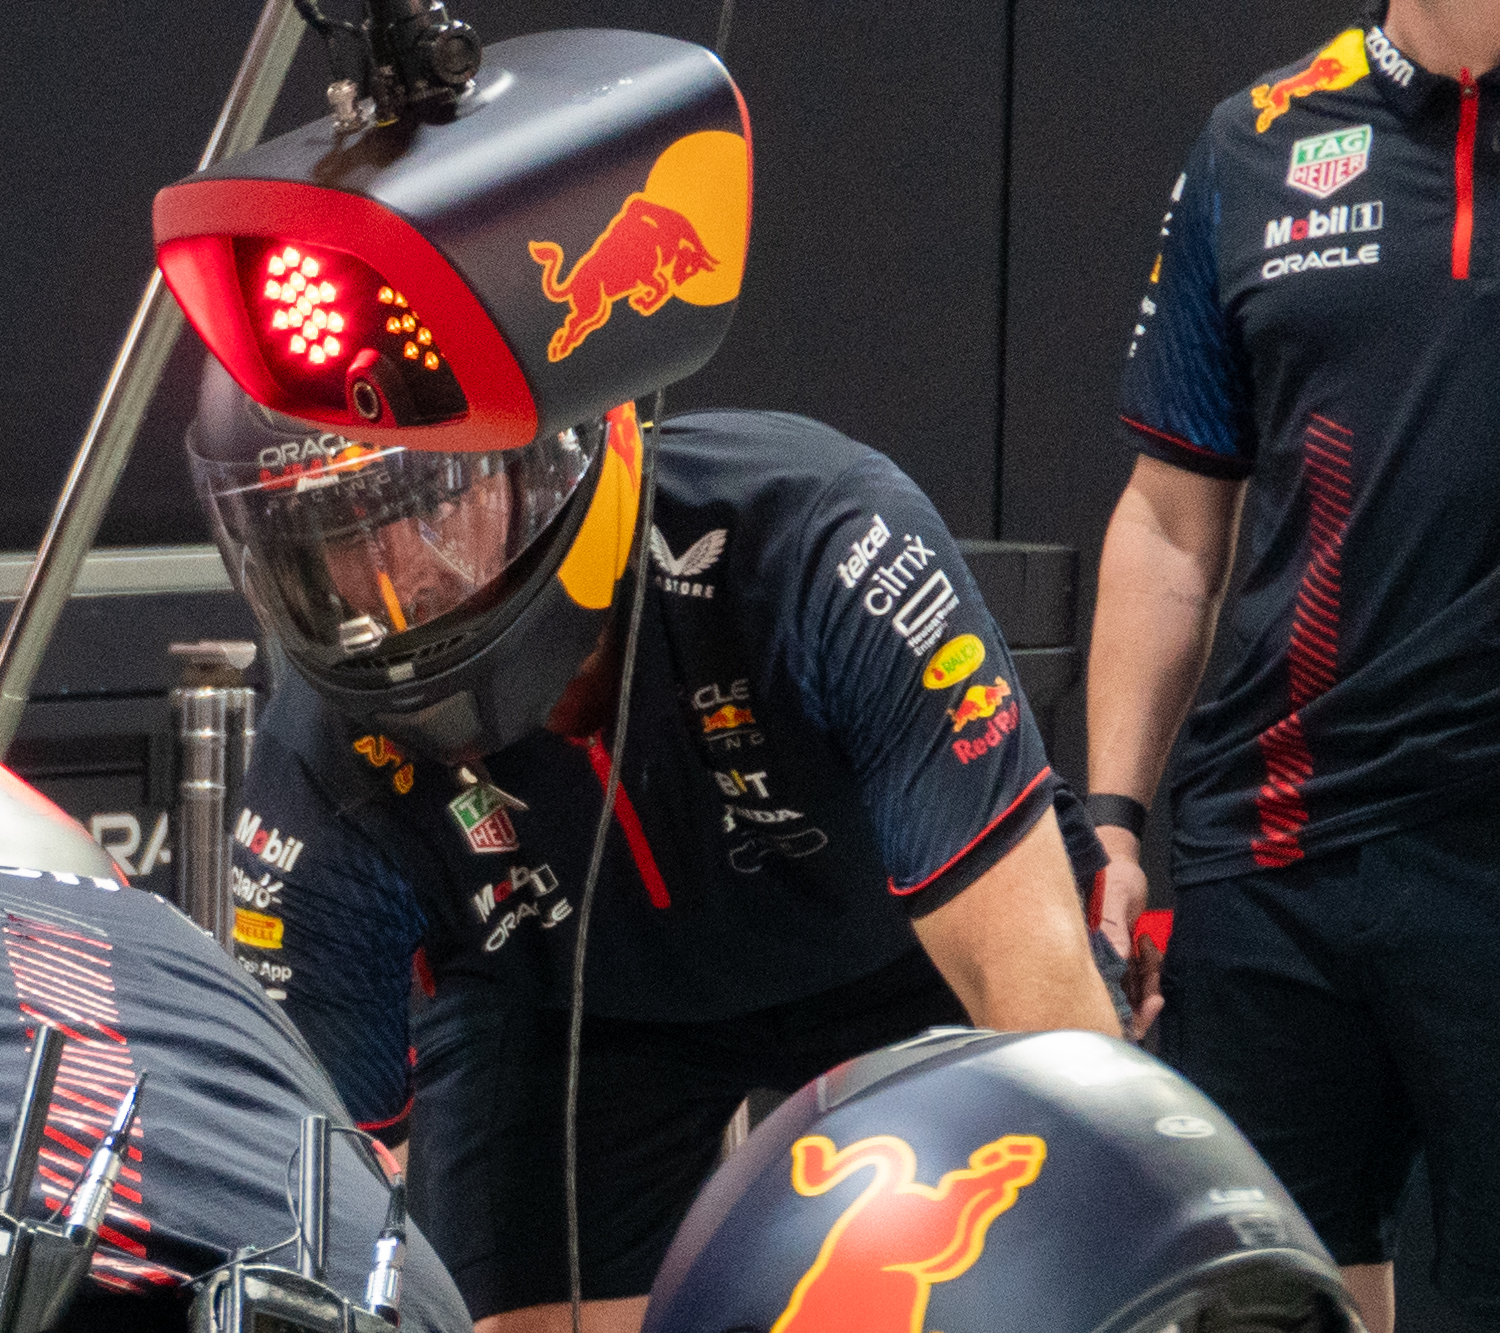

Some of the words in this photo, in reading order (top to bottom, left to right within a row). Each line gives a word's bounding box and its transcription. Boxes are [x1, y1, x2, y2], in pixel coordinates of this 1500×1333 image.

[1365, 25, 1415, 88] zoom
[1301, 130, 1365, 164] TAG
[1292, 153, 1364, 189] HEUER
[1263, 206, 1350, 249] Mobil
[1261, 243, 1381, 281] ORACLE
[836, 513, 891, 589] telcel
[864, 533, 936, 616] citrix
[233, 807, 305, 873] Mobil
[259, 960, 293, 982] App
